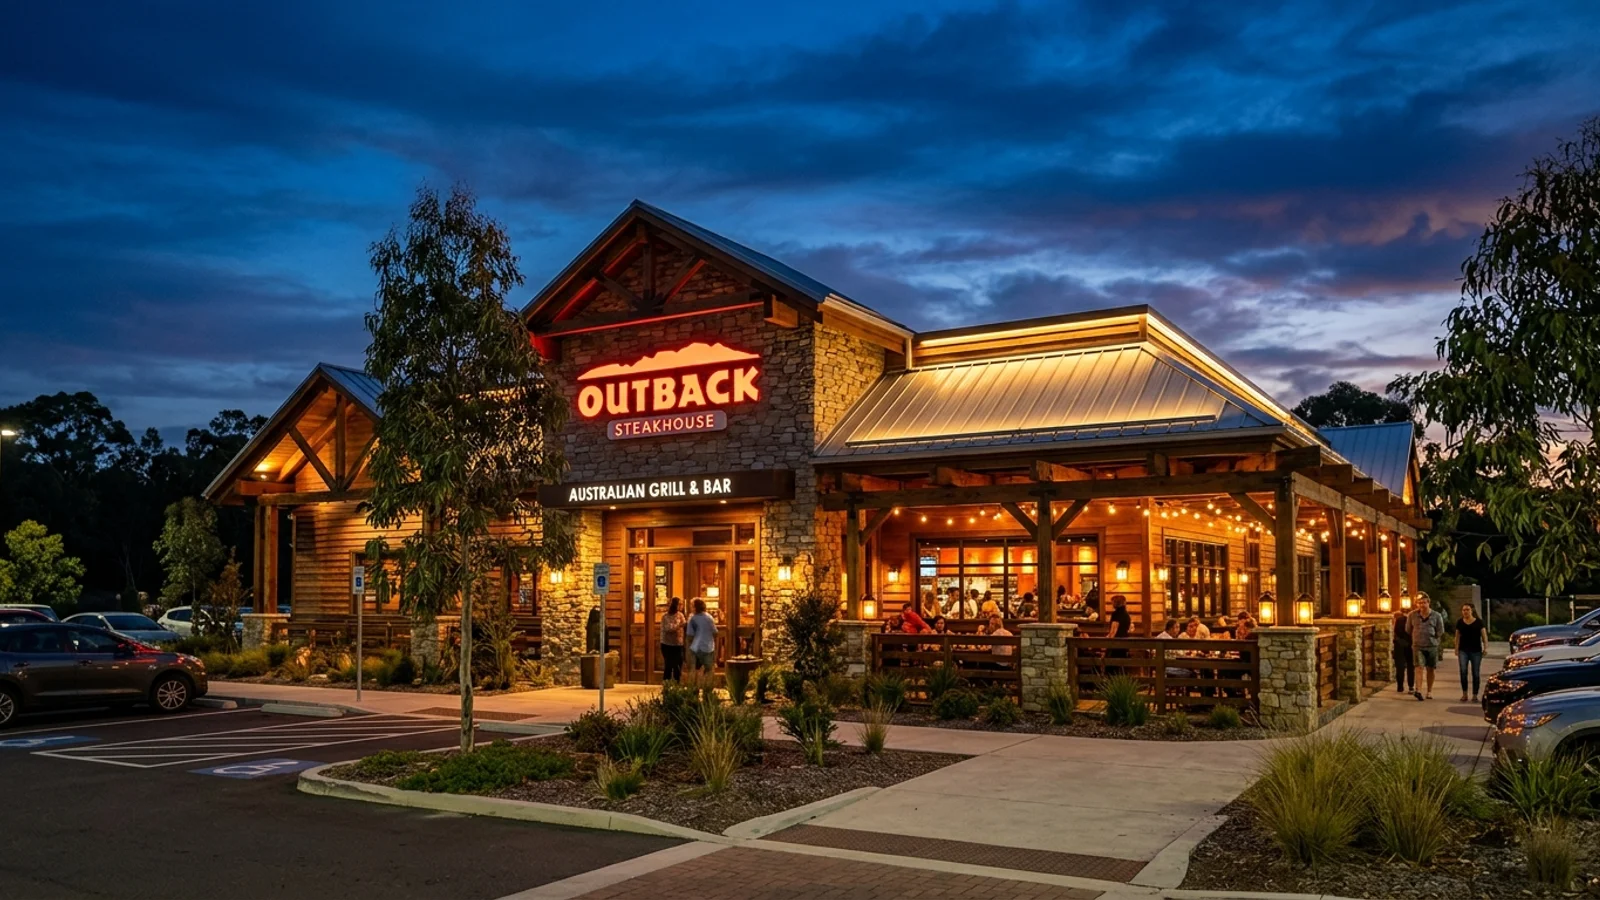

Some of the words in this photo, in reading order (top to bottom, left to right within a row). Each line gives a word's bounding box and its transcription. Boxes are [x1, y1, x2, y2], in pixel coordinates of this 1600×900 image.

[577, 366, 760, 418] OUTBACK
[614, 413, 715, 437] STEAKHOUSE
[568, 483, 646, 502] AUSTRALIAN
[649, 480, 686, 498] GRILL
[689, 480, 699, 496] &
[703, 478, 732, 495] BAR
